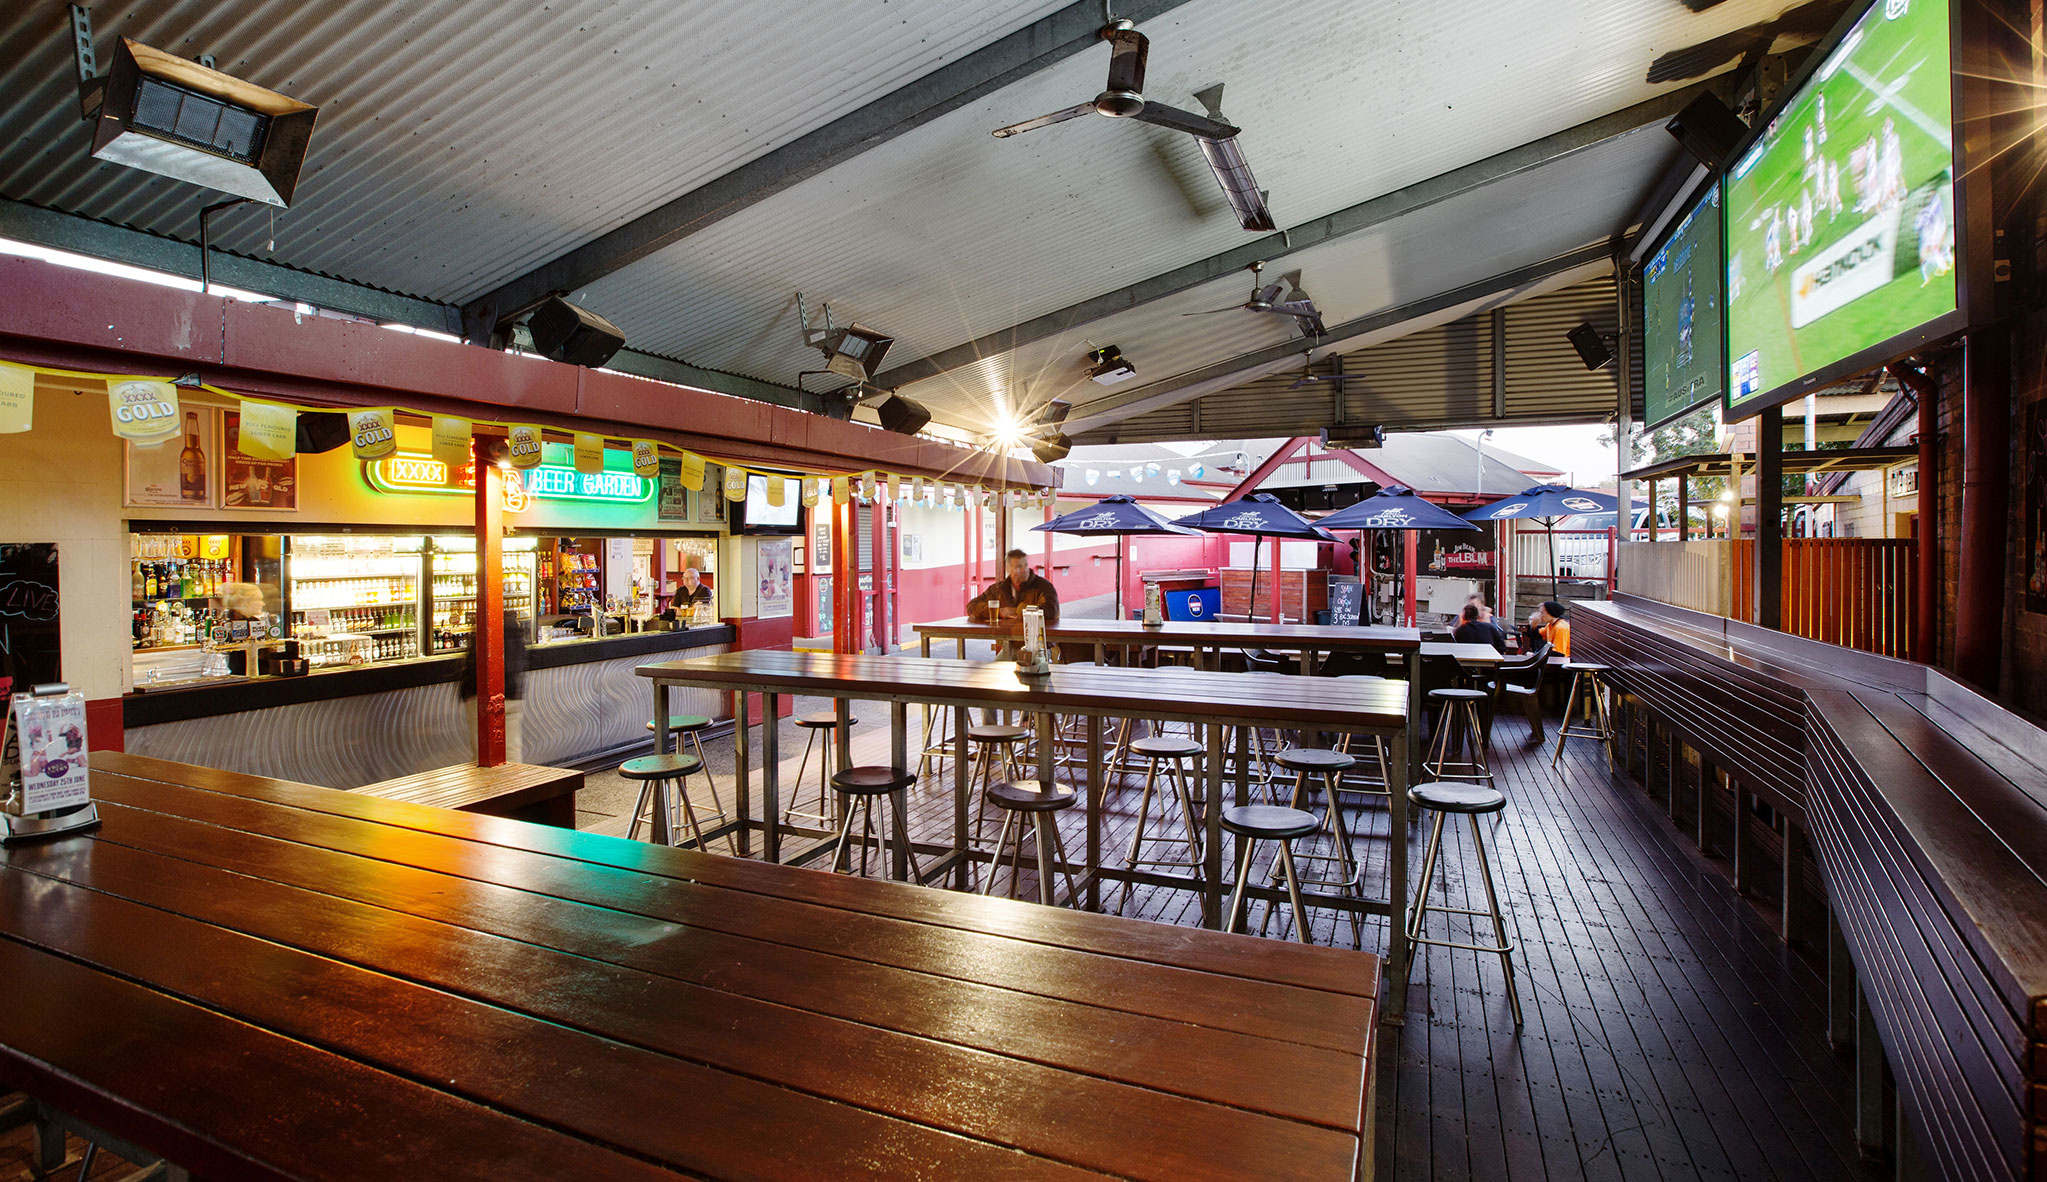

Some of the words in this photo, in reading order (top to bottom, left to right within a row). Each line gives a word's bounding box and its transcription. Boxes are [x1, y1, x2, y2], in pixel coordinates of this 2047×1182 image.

[117, 401, 175, 423] GOLD
[359, 421, 381, 431] XXXX
[355, 427, 393, 448] GOLD
[511, 442, 540, 456] GOLD
[635, 455, 657, 468] GOLD
[396, 460, 442, 481] XXXX
[533, 469, 575, 493] BEER
[583, 473, 642, 497] GARDEN
[1079, 519, 1120, 529] DRY
[1224, 519, 1269, 529] DRY
[1366, 517, 1416, 527] DRY
[8, 587, 51, 612] LIVE
[28, 779, 59, 791] WEDNESDAY
